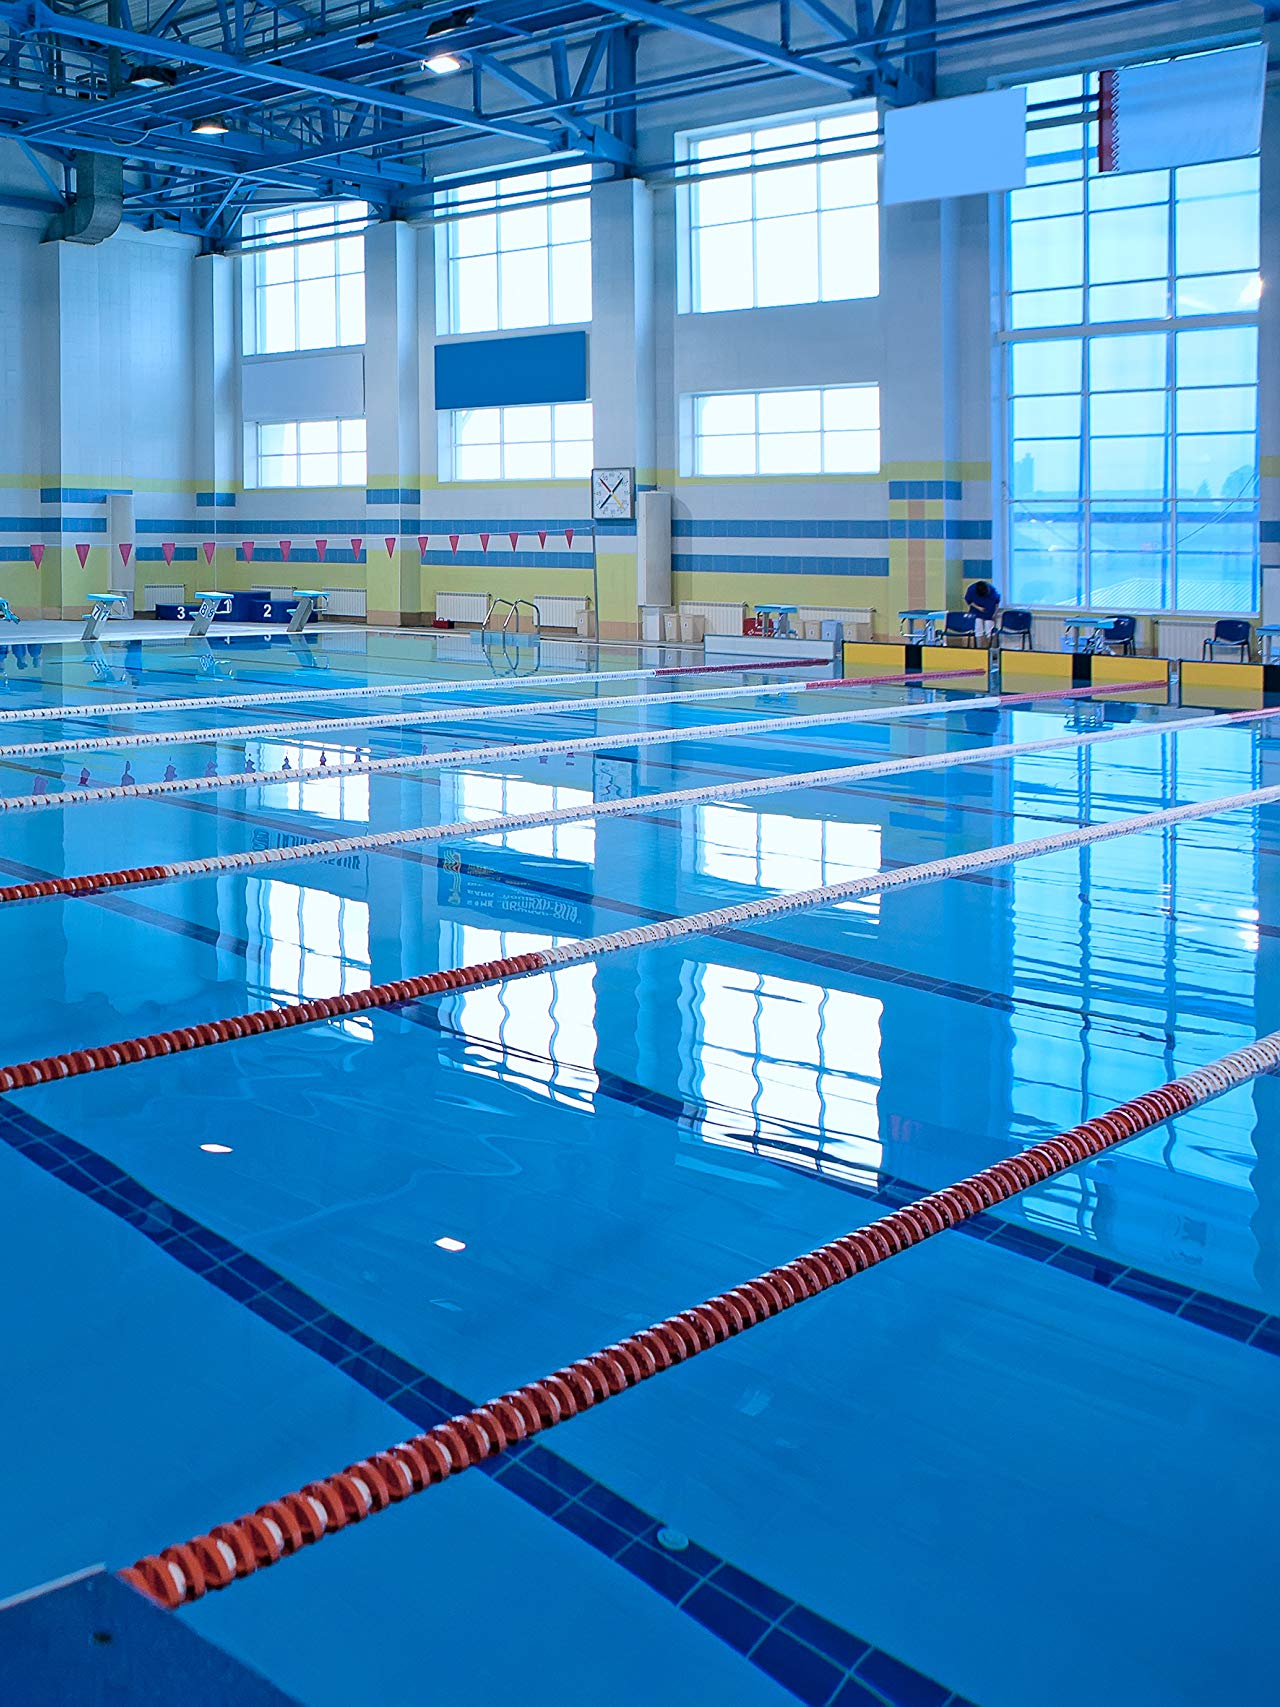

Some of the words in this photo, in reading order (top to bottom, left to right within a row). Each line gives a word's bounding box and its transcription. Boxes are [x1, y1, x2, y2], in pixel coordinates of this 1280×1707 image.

[93, 605, 100, 617] 7
[176, 606, 186, 620] 3
[201, 603, 208, 616] 8
[263, 604, 272, 618] 2
